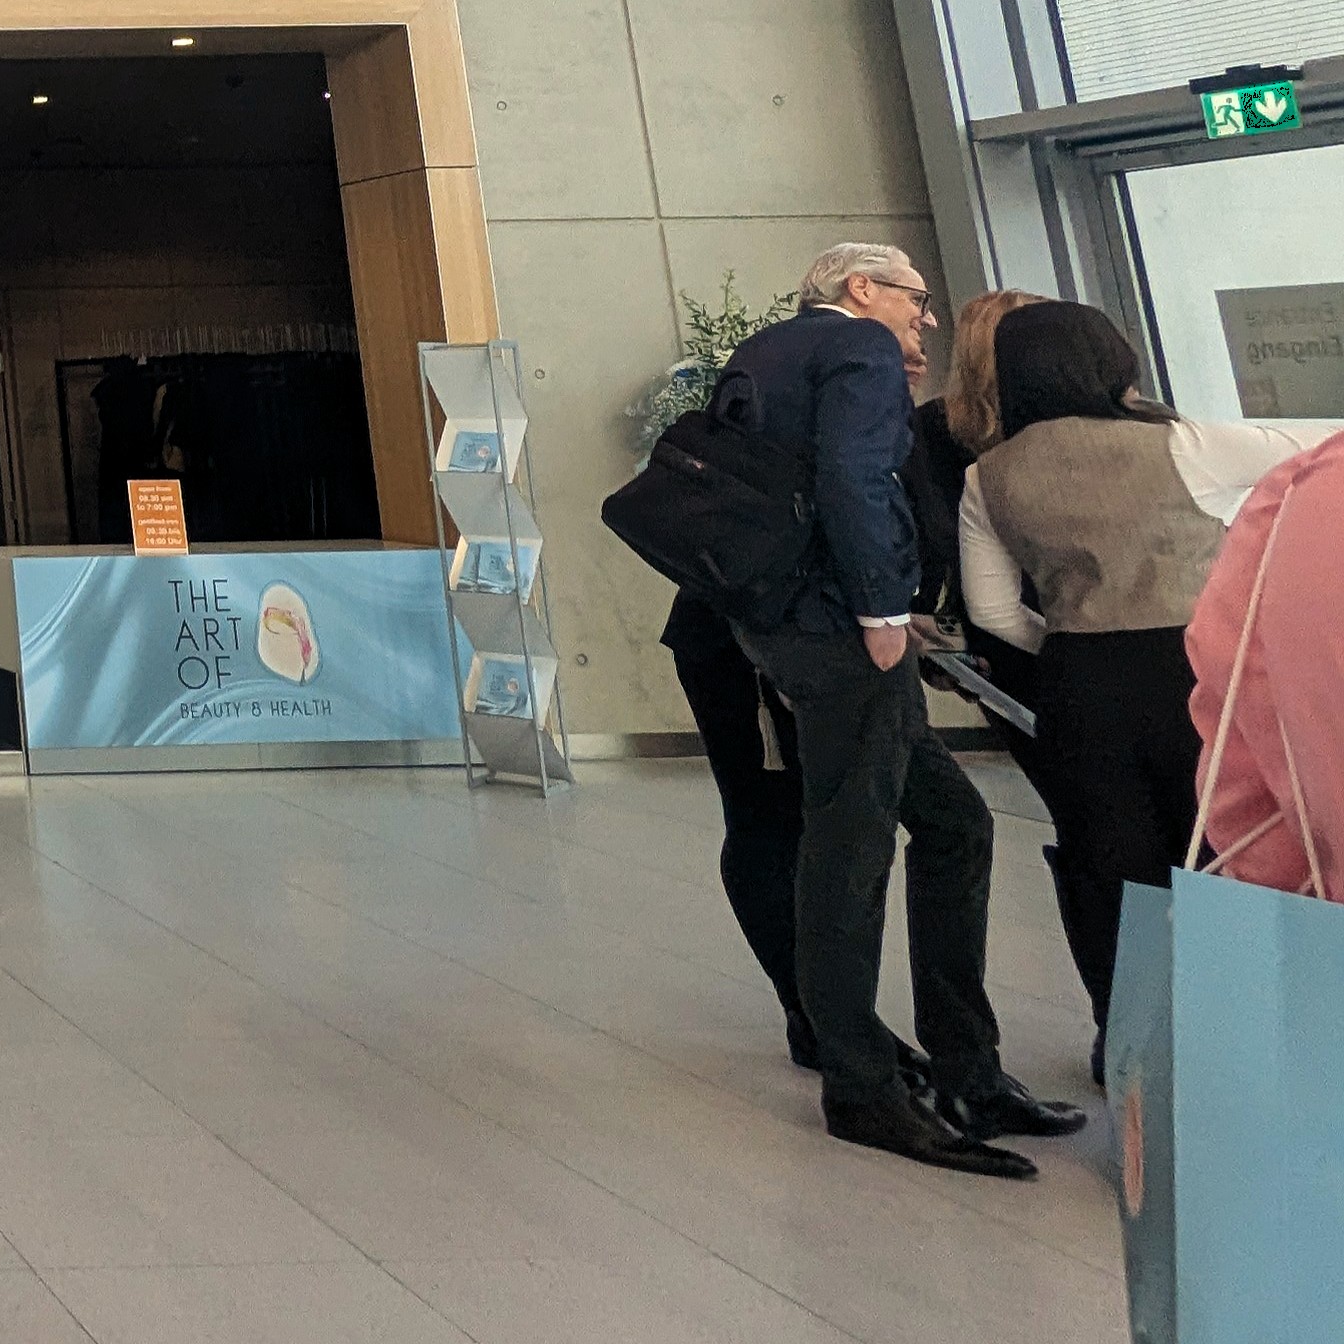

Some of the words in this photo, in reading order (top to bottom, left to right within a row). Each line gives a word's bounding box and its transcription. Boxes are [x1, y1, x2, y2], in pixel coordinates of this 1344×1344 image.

[168, 579, 231, 613] THE
[175, 617, 241, 651] ART
[177, 656, 232, 690] OF
[180, 702, 241, 719] BEAUTY
[270, 700, 333, 717] HEALTH
